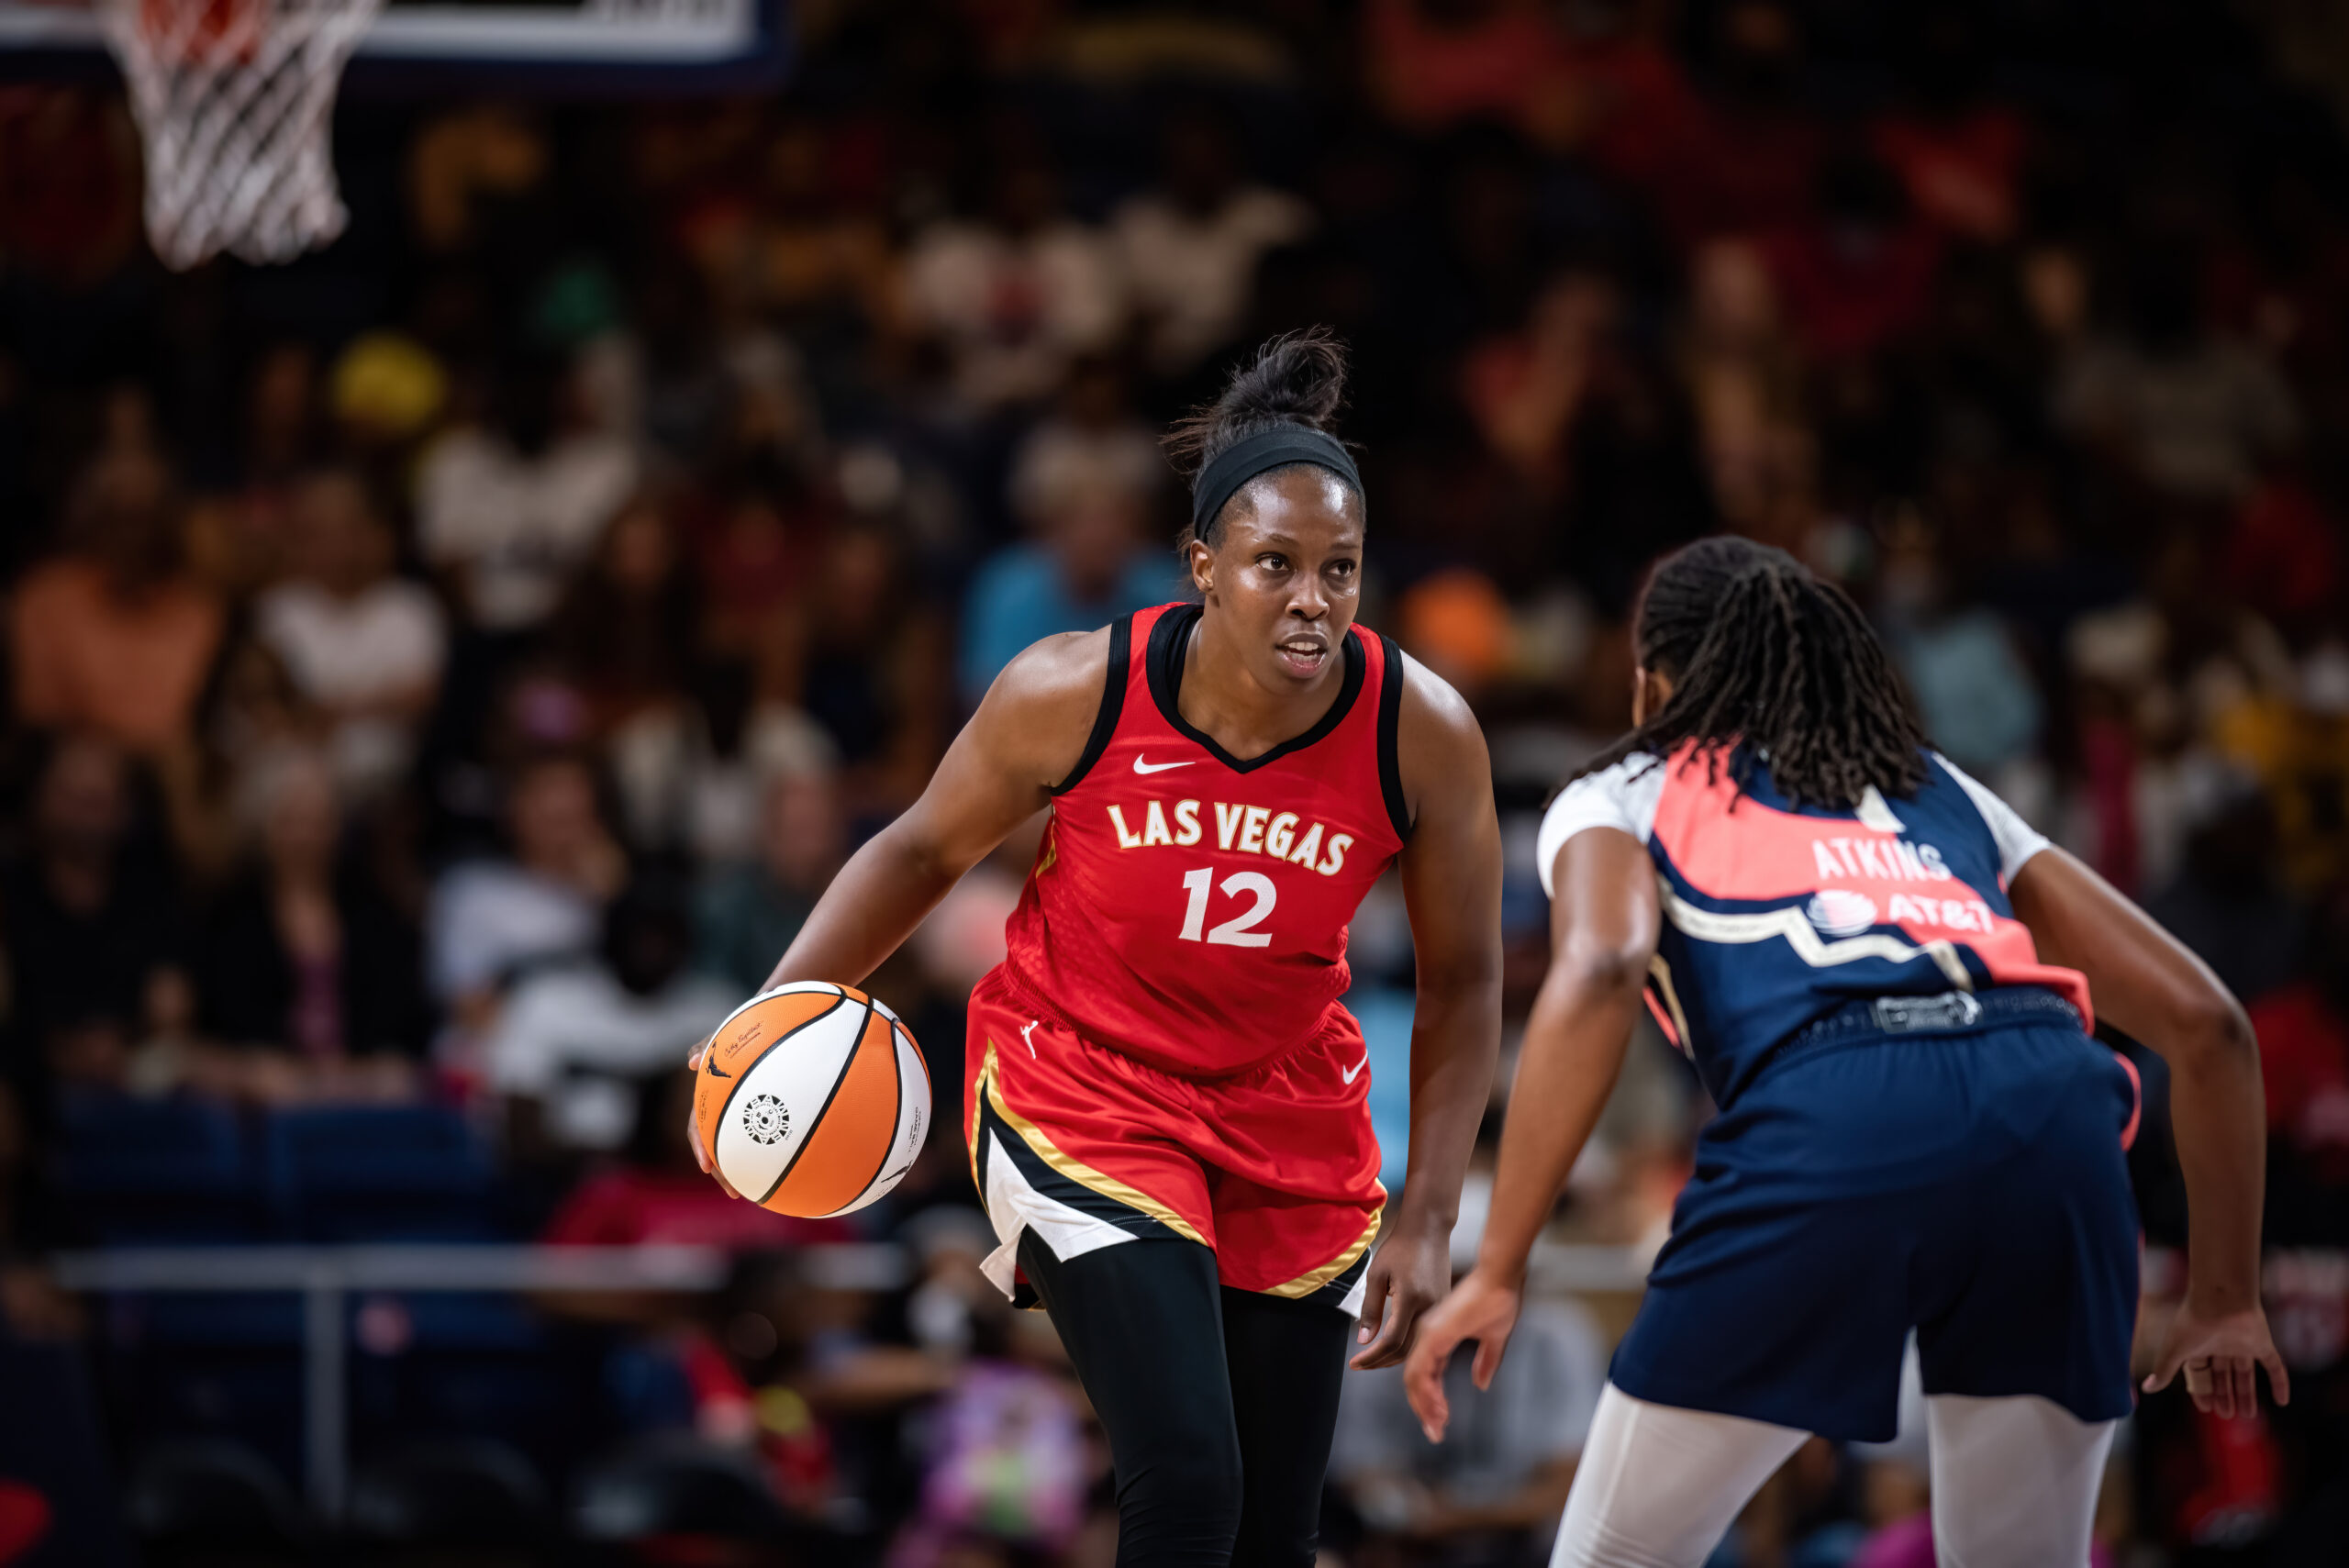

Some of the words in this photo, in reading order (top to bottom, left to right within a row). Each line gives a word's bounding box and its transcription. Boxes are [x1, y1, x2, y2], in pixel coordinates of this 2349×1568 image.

[1107, 799, 1203, 850] LAS
[1214, 802, 1354, 876] VEGAS
[1811, 838, 1953, 881] ATKINS
[1178, 866, 1277, 948] 12
[1888, 893, 1995, 935] AT&T
